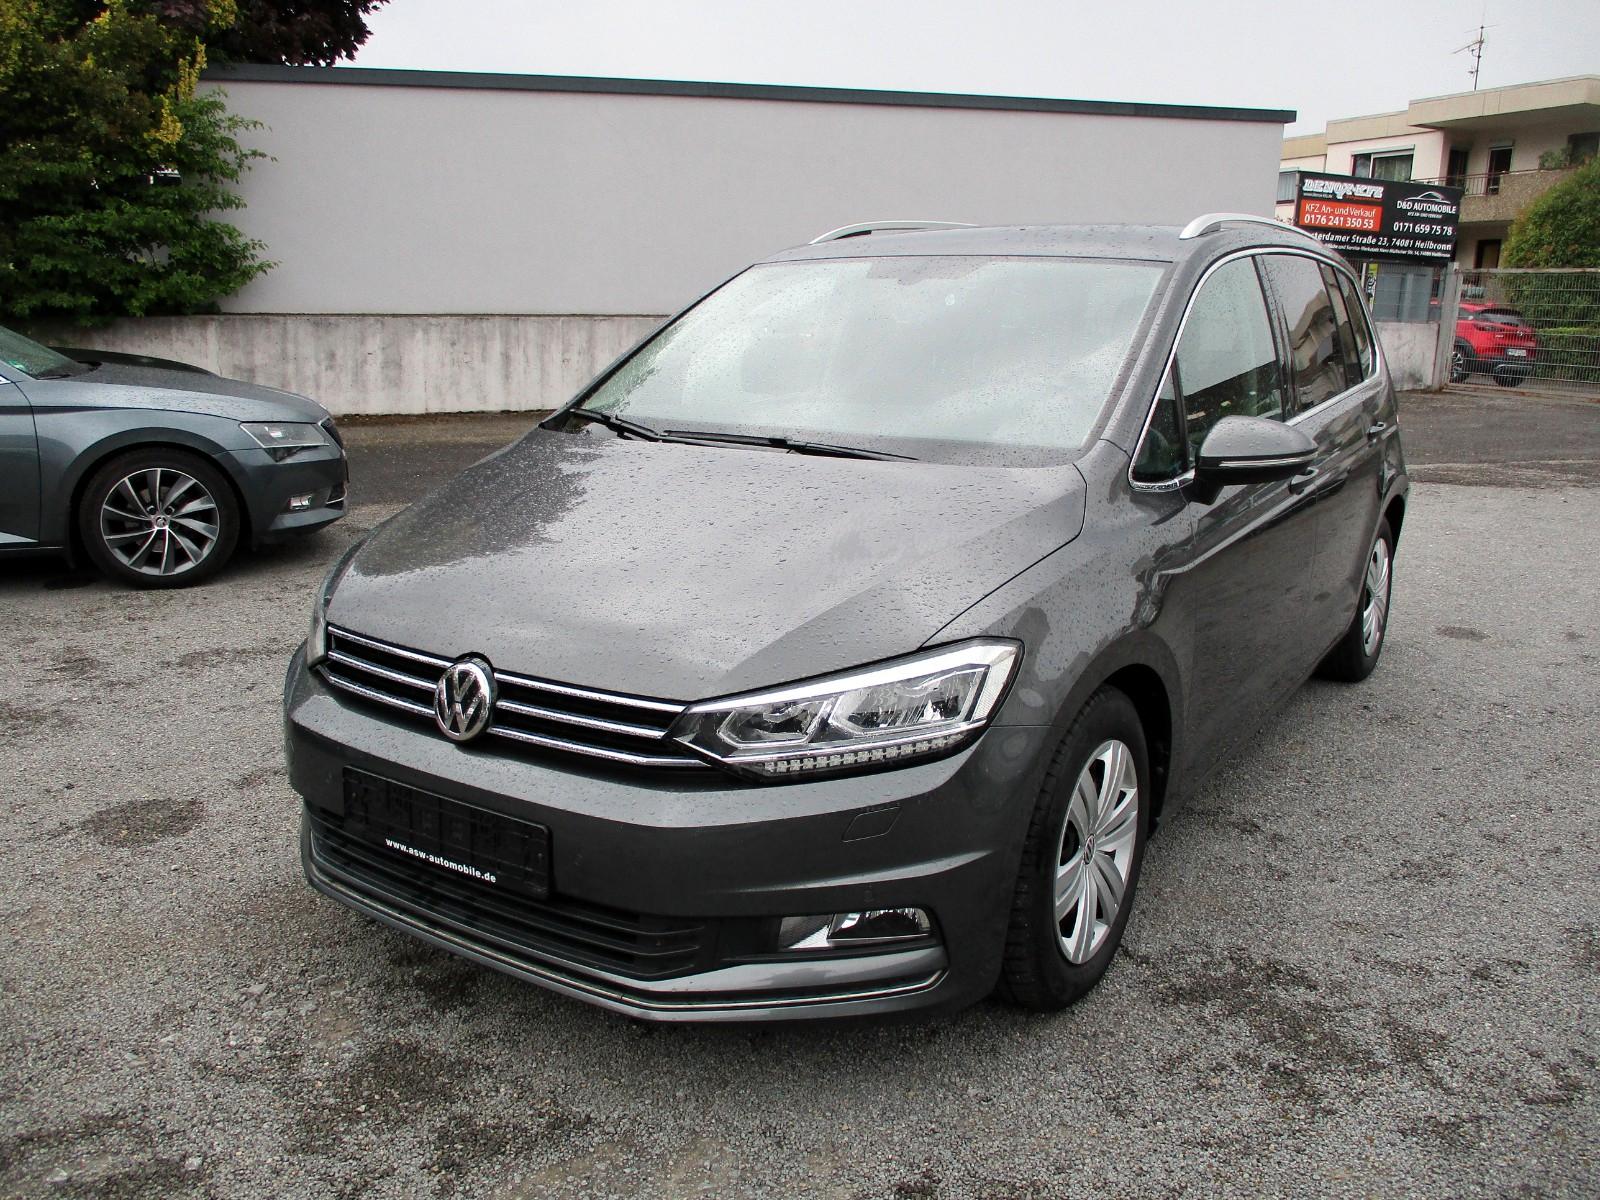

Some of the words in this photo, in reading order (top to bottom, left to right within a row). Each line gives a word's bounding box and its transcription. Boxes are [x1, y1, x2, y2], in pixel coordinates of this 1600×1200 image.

[1306, 204, 1320, 212] KFZ
[1321, 205, 1334, 214] An-
[1335, 207, 1348, 216] und
[1349, 208, 1376, 218] Verkauf
[1396, 200, 1412, 210] D&D
[1413, 203, 1457, 214] AUTOMOBILE
[1304, 214, 1327, 224] 0176
[1328, 216, 1344, 226] 241
[1346, 218, 1362, 227] 350
[1363, 220, 1374, 229] 53
[1393, 222, 1413, 233] 0171
[1415, 224, 1430, 234] 659
[1432, 225, 1441, 235] 75
[1442, 226, 1453, 236] 78
[1350, 235, 1376, 245] Straße
[1378, 238, 1389, 247] 23,
[1392, 238, 1413, 247] 74081
[1415, 240, 1452, 251] Heilbronn
[385, 838, 497, 884] www.asw-automobile.de
